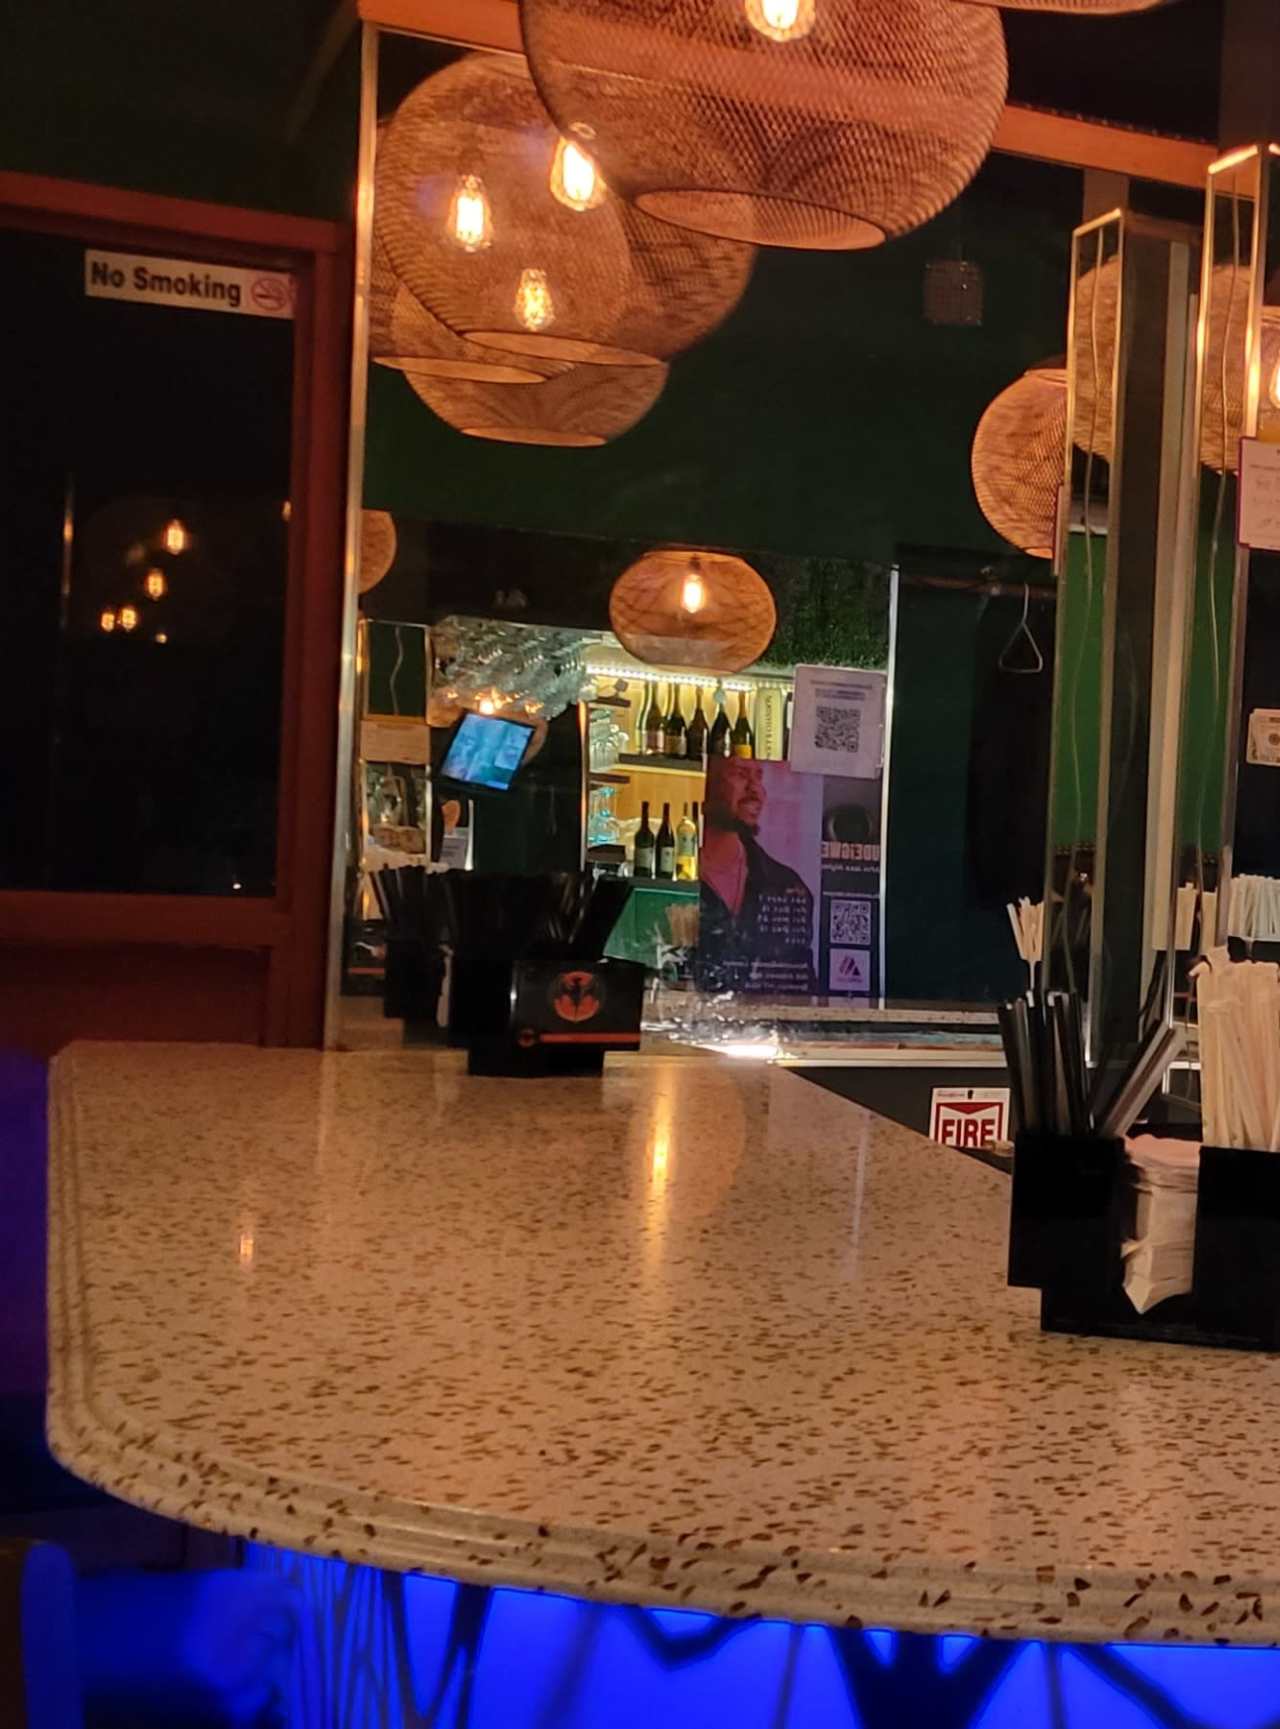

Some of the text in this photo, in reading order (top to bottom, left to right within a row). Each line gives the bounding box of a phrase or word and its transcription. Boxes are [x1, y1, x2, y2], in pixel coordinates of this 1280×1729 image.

[90, 262, 242, 307] No Smoking
[942, 1118, 996, 1147] FIRE
